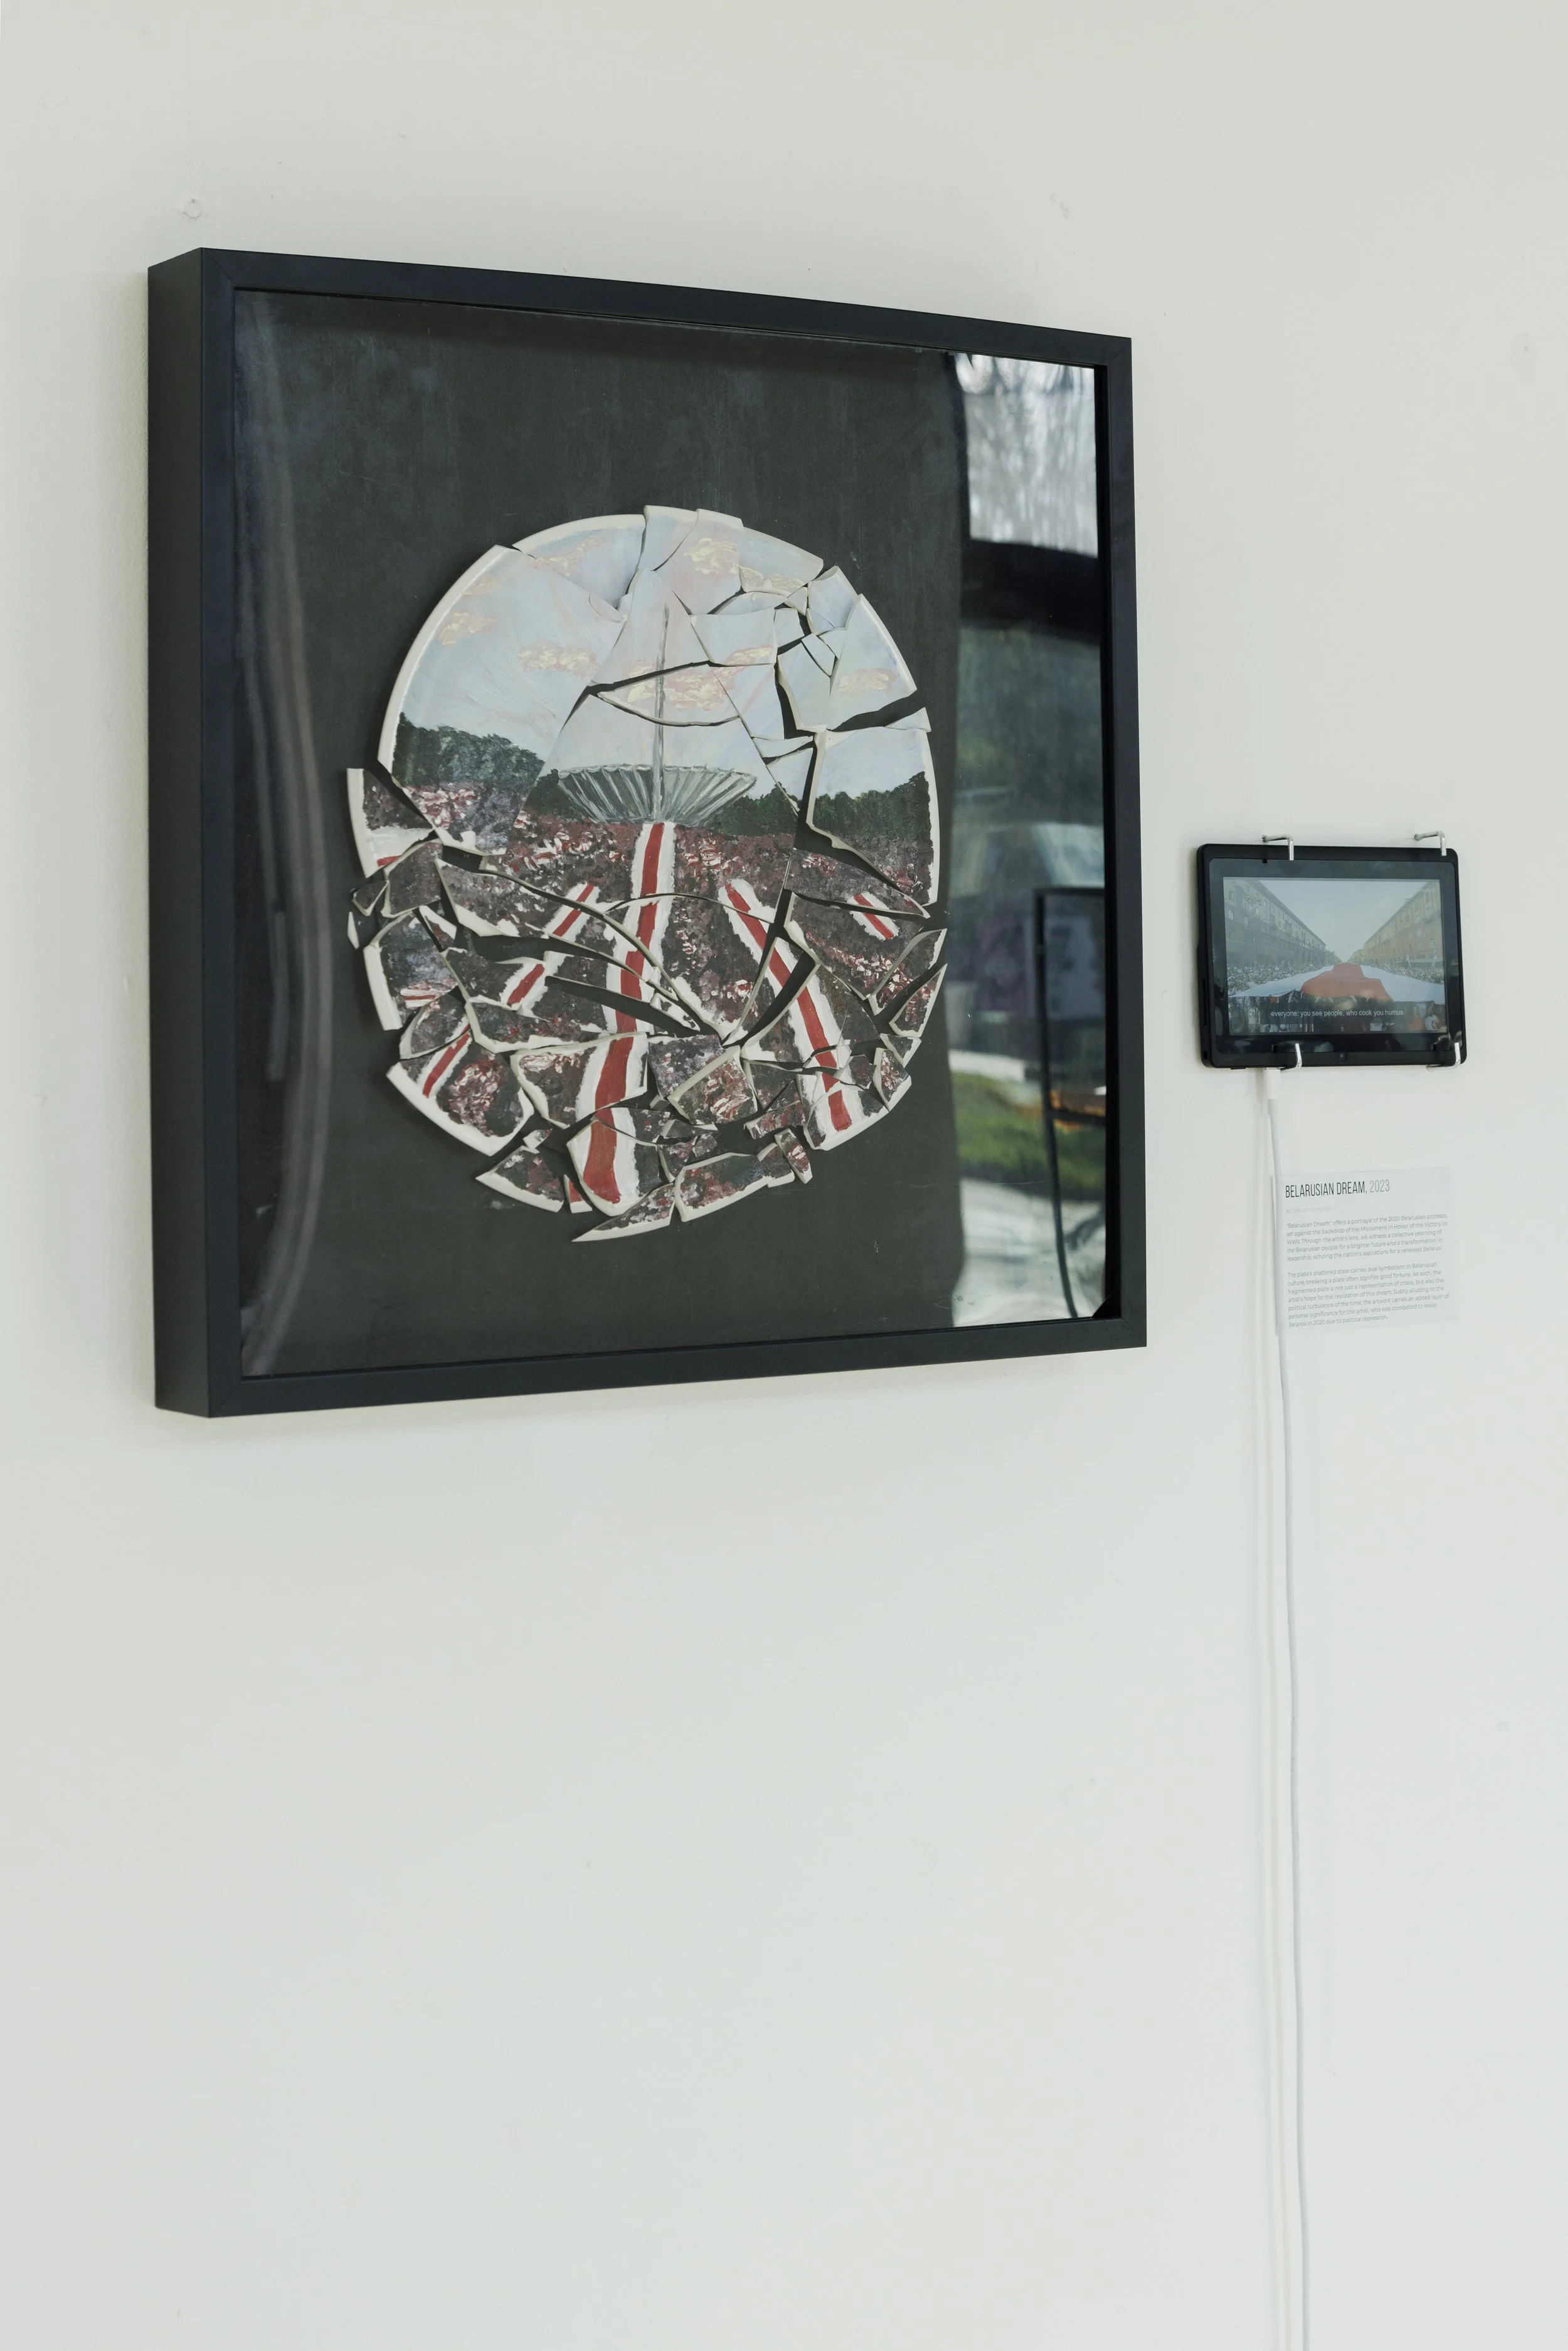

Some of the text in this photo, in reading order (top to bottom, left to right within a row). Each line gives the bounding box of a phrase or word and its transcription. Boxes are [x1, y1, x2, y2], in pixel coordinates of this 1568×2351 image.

[1285, 1179, 1390, 1198] BELARUSIAN DREAM, 2023
[1288, 1312, 1308, 1320] personal
[1342, 1316, 1361, 1324] political
